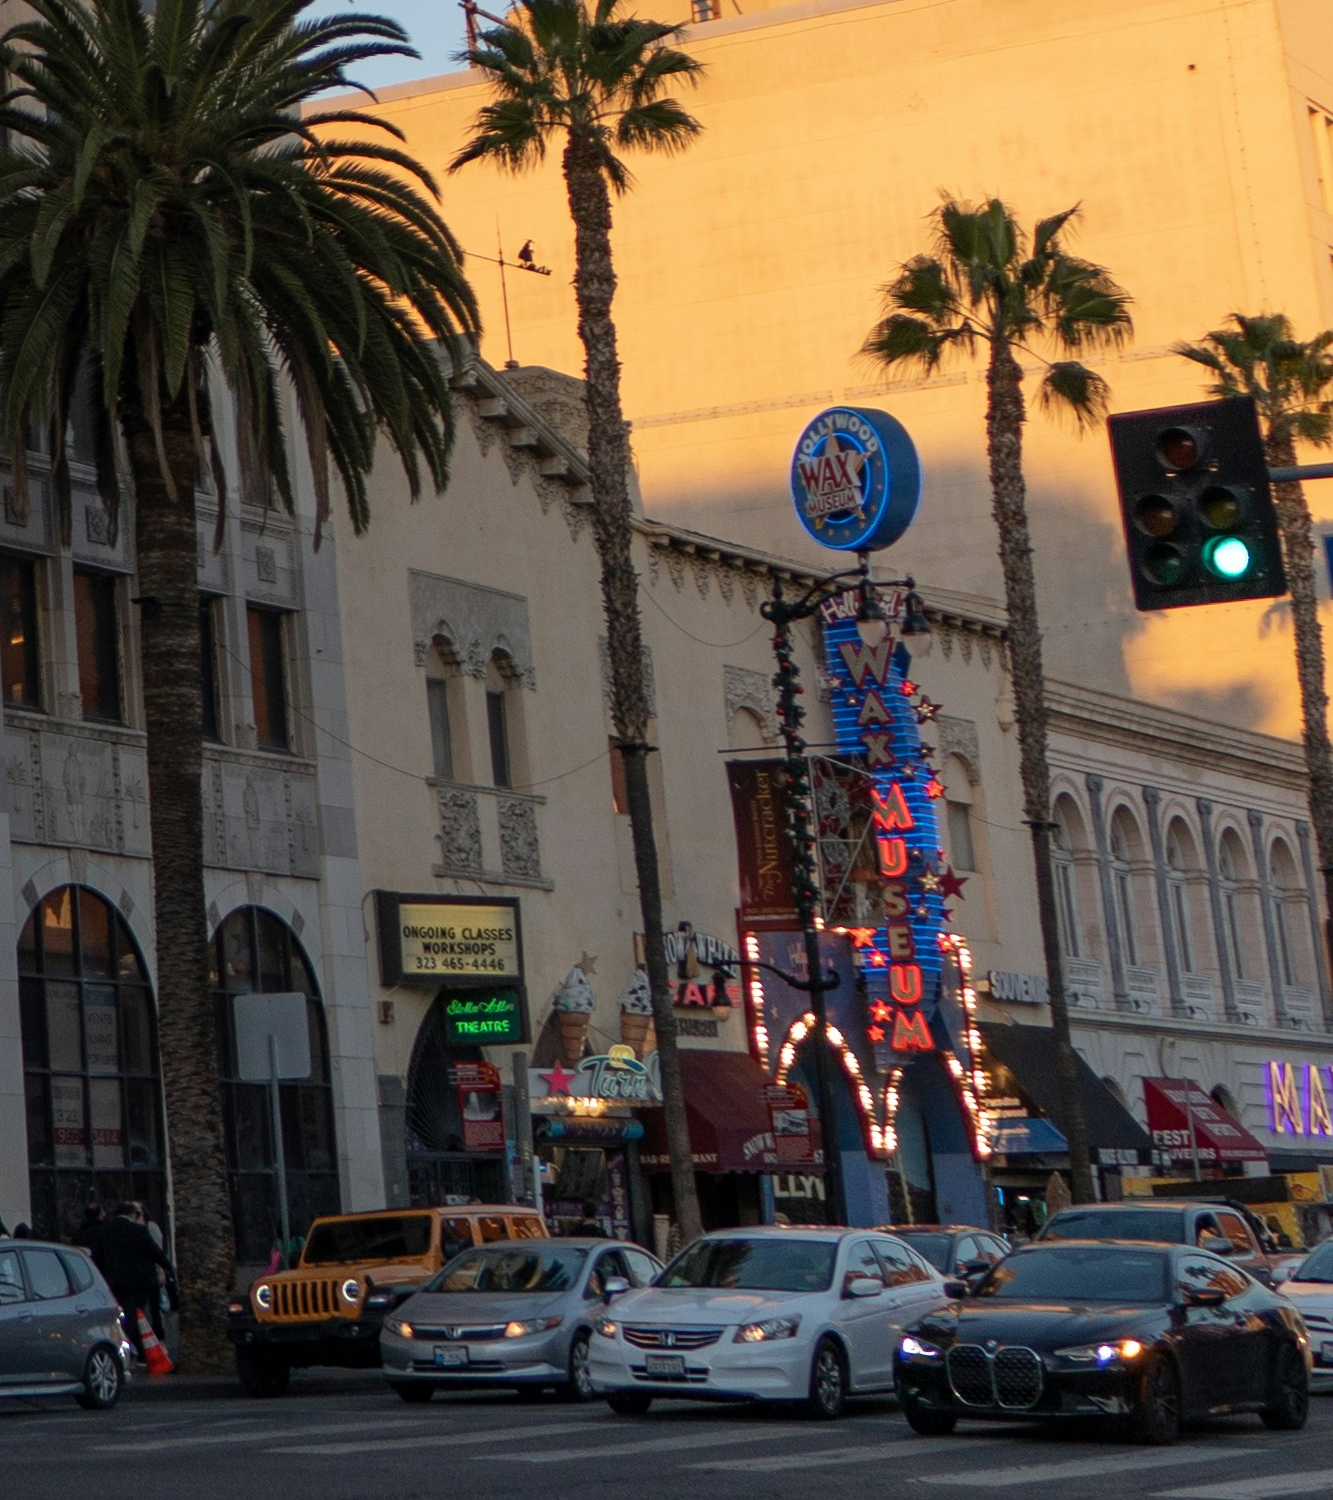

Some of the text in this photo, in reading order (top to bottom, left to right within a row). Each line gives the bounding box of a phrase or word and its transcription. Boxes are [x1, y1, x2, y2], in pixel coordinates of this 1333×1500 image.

[798, 450, 858, 494] WAX
[807, 491, 860, 516] MUSEUM
[837, 636, 900, 771] WAX
[755, 770, 782, 882] Nutcracker
[869, 780, 936, 1052] MUSEUM
[403, 925, 513, 941] ONGOING CLASSES
[422, 942, 496, 956] WORKSHOPS
[416, 957, 505, 971] 323 465-4446
[455, 1020, 510, 1033] THEATRE
